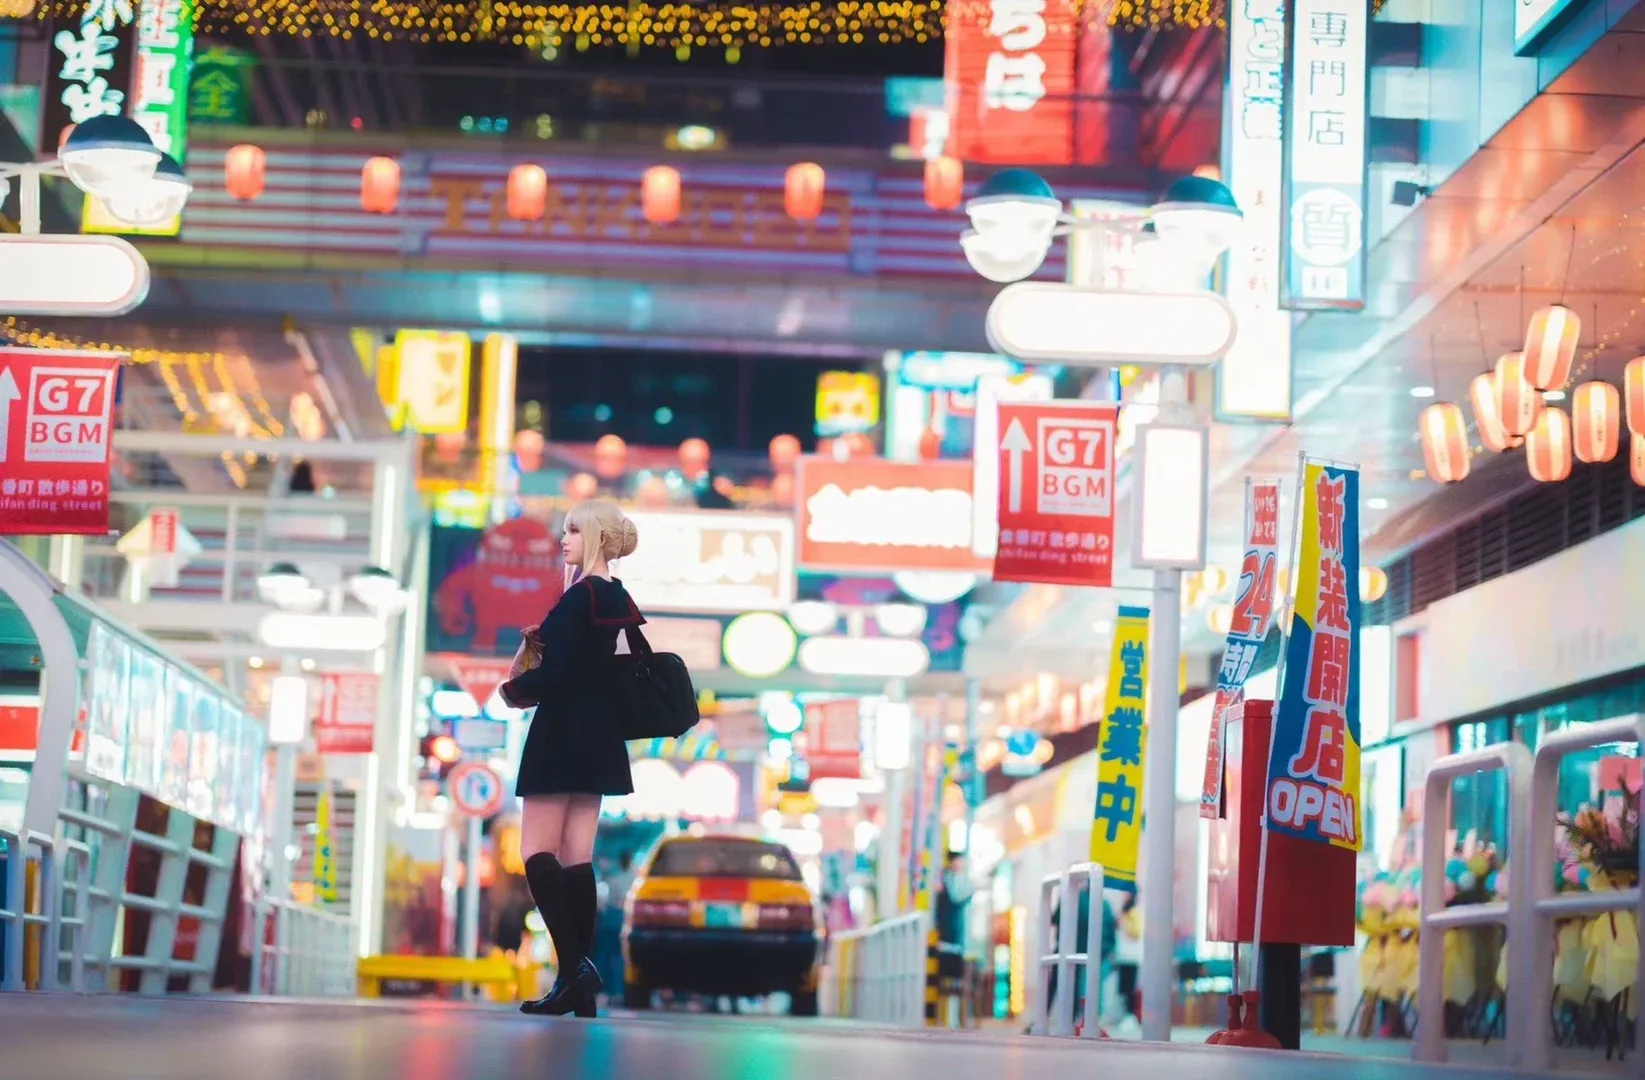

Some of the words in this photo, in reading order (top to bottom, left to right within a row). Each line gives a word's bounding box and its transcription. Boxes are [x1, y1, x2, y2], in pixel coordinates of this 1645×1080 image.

[38, 377, 101, 412] G7
[30, 422, 102, 444] BGM
[1047, 429, 1102, 466] G7
[38, 479, 104, 496] 散歩通り
[1042, 474, 1105, 498] BGM
[28, 499, 57, 513] ding
[62, 499, 103, 511] street
[1071, 551, 1108, 565] street
[1230, 551, 1277, 637] 24
[1093, 639, 1146, 843] 営業中
[1270, 779, 1355, 842] OPEN
